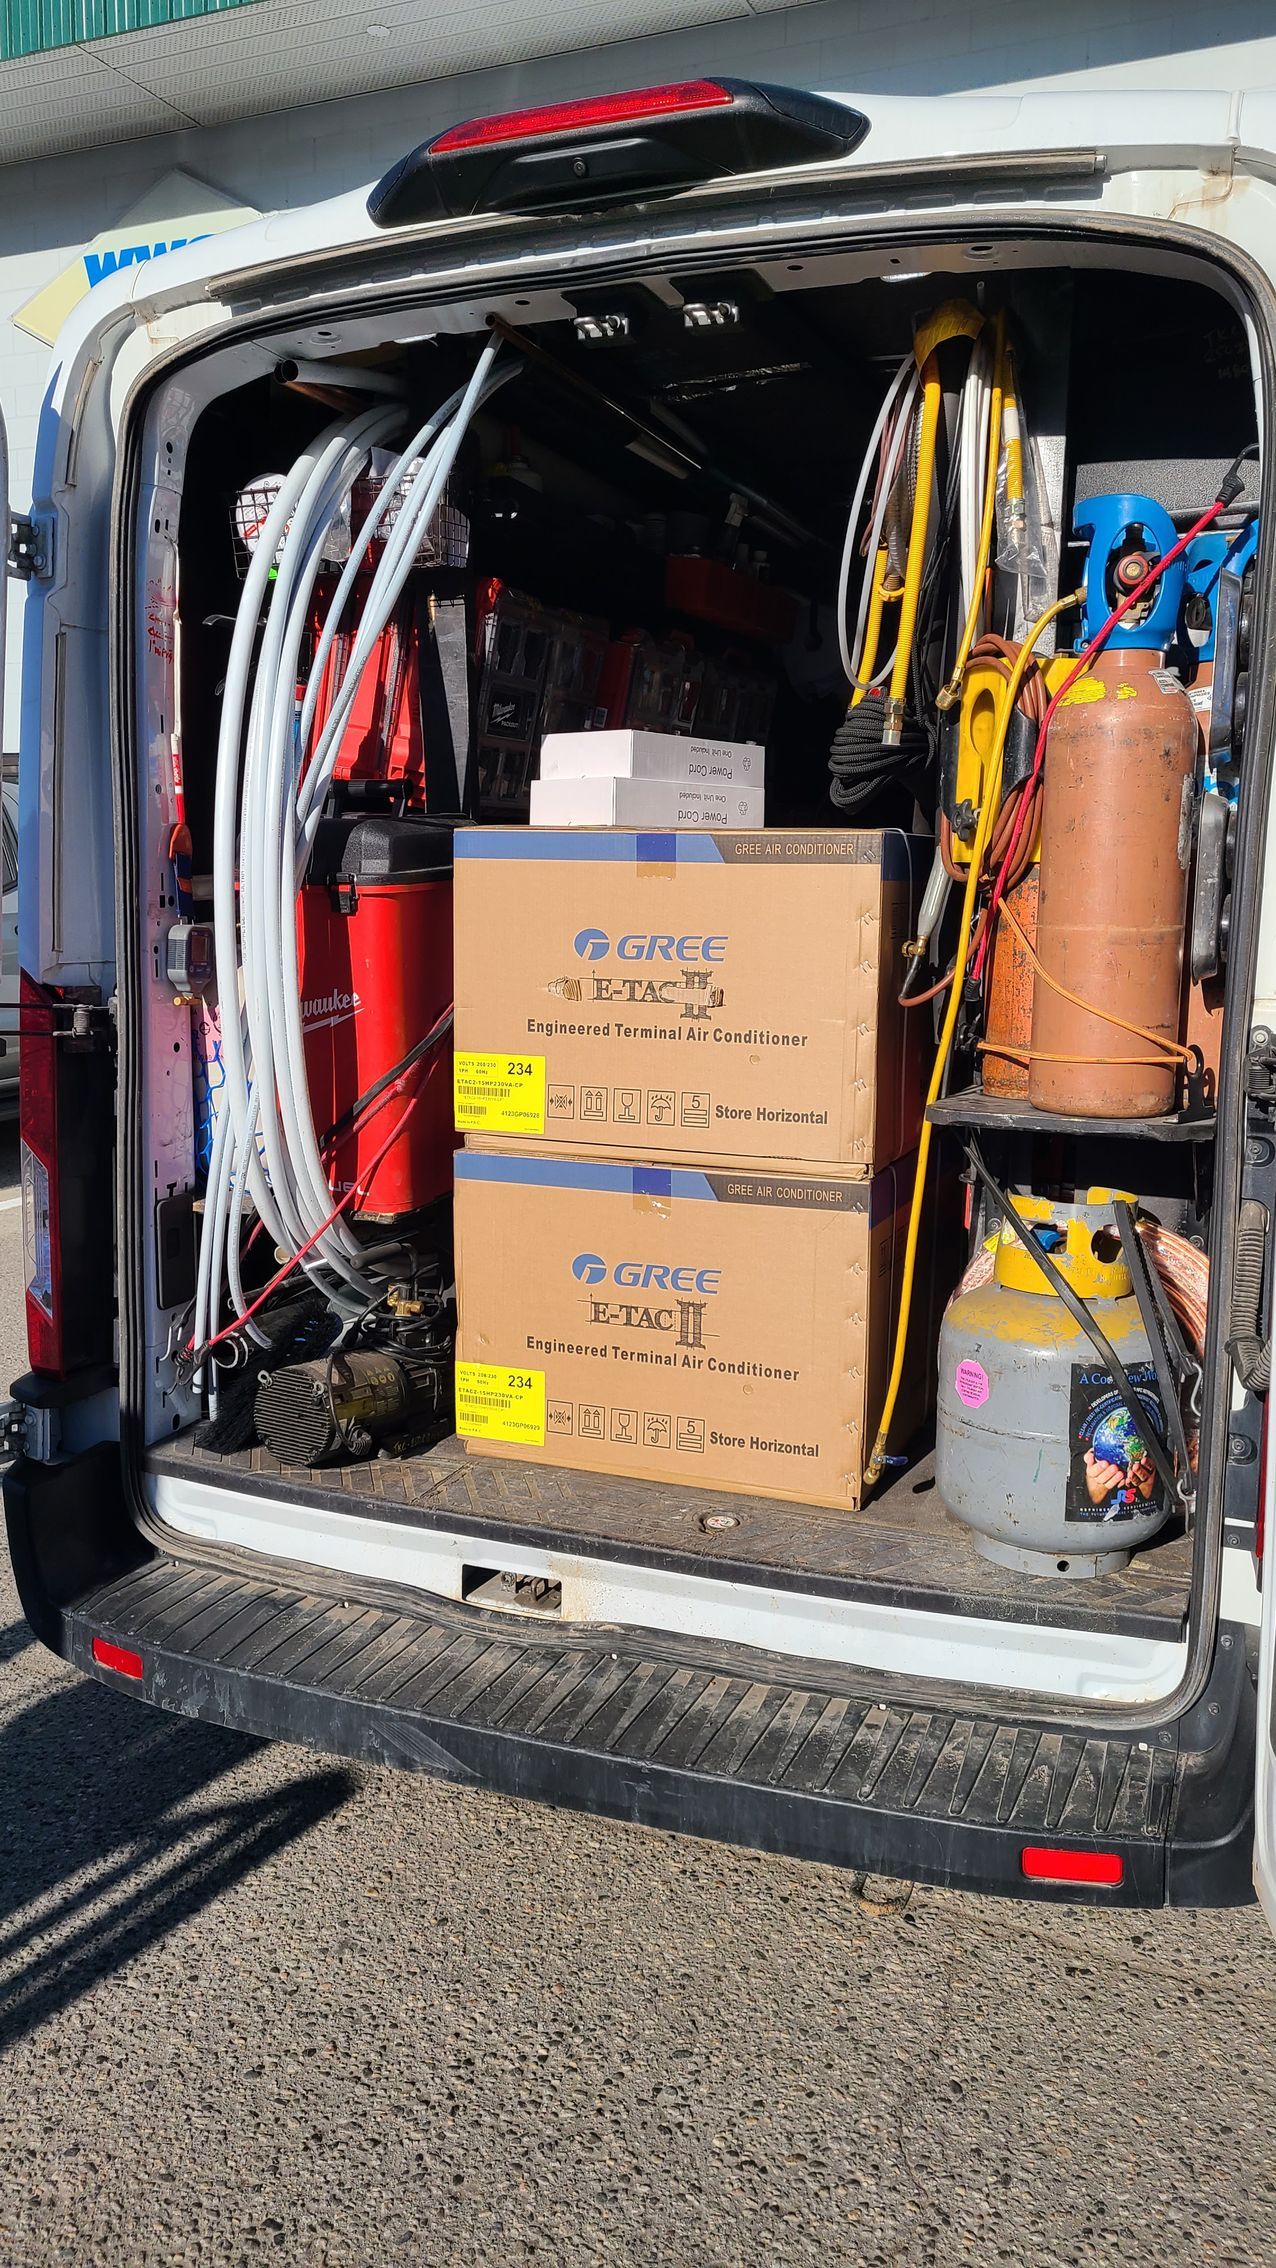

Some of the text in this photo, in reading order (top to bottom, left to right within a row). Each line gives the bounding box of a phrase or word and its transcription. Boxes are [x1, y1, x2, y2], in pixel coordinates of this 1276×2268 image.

[690, 745, 732, 758] One Unit Included
[688, 763, 733, 779] Power Cord
[679, 791, 726, 803] One Unit Included
[677, 809, 728, 824] Power Cord
[735, 843, 855, 855] GREE AIR CONDITIONER
[616, 934, 729, 962] GREE
[302, 988, 362, 1018] waukee
[527, 1018, 808, 1048] Engineered Terminal Air Conditioner
[507, 1062, 533, 1076] 234
[691, 1095, 701, 1109] 5
[715, 1104, 828, 1125] Store Horizontal
[328, 1179, 370, 1197] UEL
[727, 1183, 843, 1202] GREE AIR CONDITIONER
[613, 1262, 722, 1295] GREE
[591, 1299, 708, 1350] E-TAC II
[526, 1335, 800, 1382] Engineered Terminal Air Conditioner
[508, 1375, 532, 1389] 234
[1079, 1373, 1089, 1384] A
[1128, 1374, 1142, 1383] ew
[686, 1420, 696, 1434] 5
[709, 1431, 819, 1458] Store Horizontal
